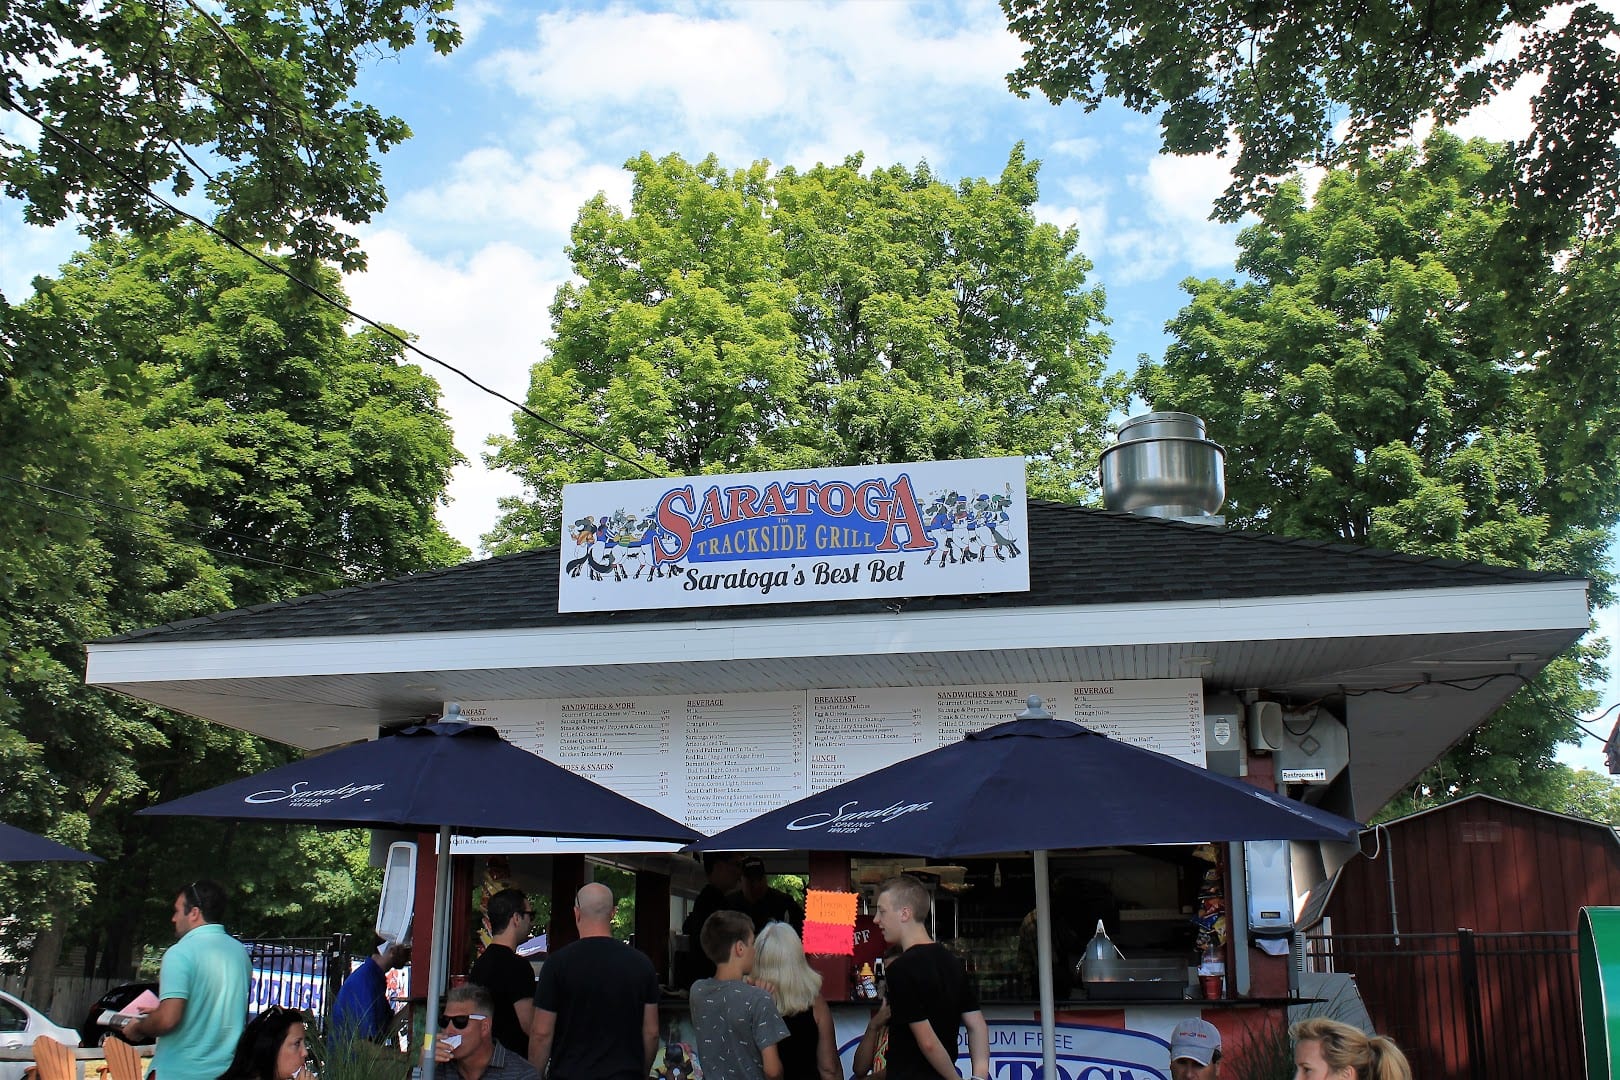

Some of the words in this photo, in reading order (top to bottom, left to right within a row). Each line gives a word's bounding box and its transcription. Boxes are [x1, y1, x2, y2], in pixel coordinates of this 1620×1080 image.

[653, 474, 936, 565] SARATOGA
[697, 524, 808, 556] TRACKSIDE
[815, 524, 875, 549] GRILL
[683, 563, 806, 594] Saratoga's
[812, 561, 859, 585] Best
[868, 559, 906, 583] Bet
[938, 690, 988, 700] SANDWICHES
[996, 690, 1018, 698] MORE
[1074, 687, 1114, 696] BEVERAGE
[687, 699, 724, 707] BEVERAGE
[814, 695, 856, 704] BREAKFAST
[561, 703, 606, 711] SANDWICHES
[812, 754, 836, 762] LUNCH
[587, 763, 614, 771] SNACKS
[786, 799, 934, 831] Saratoga
